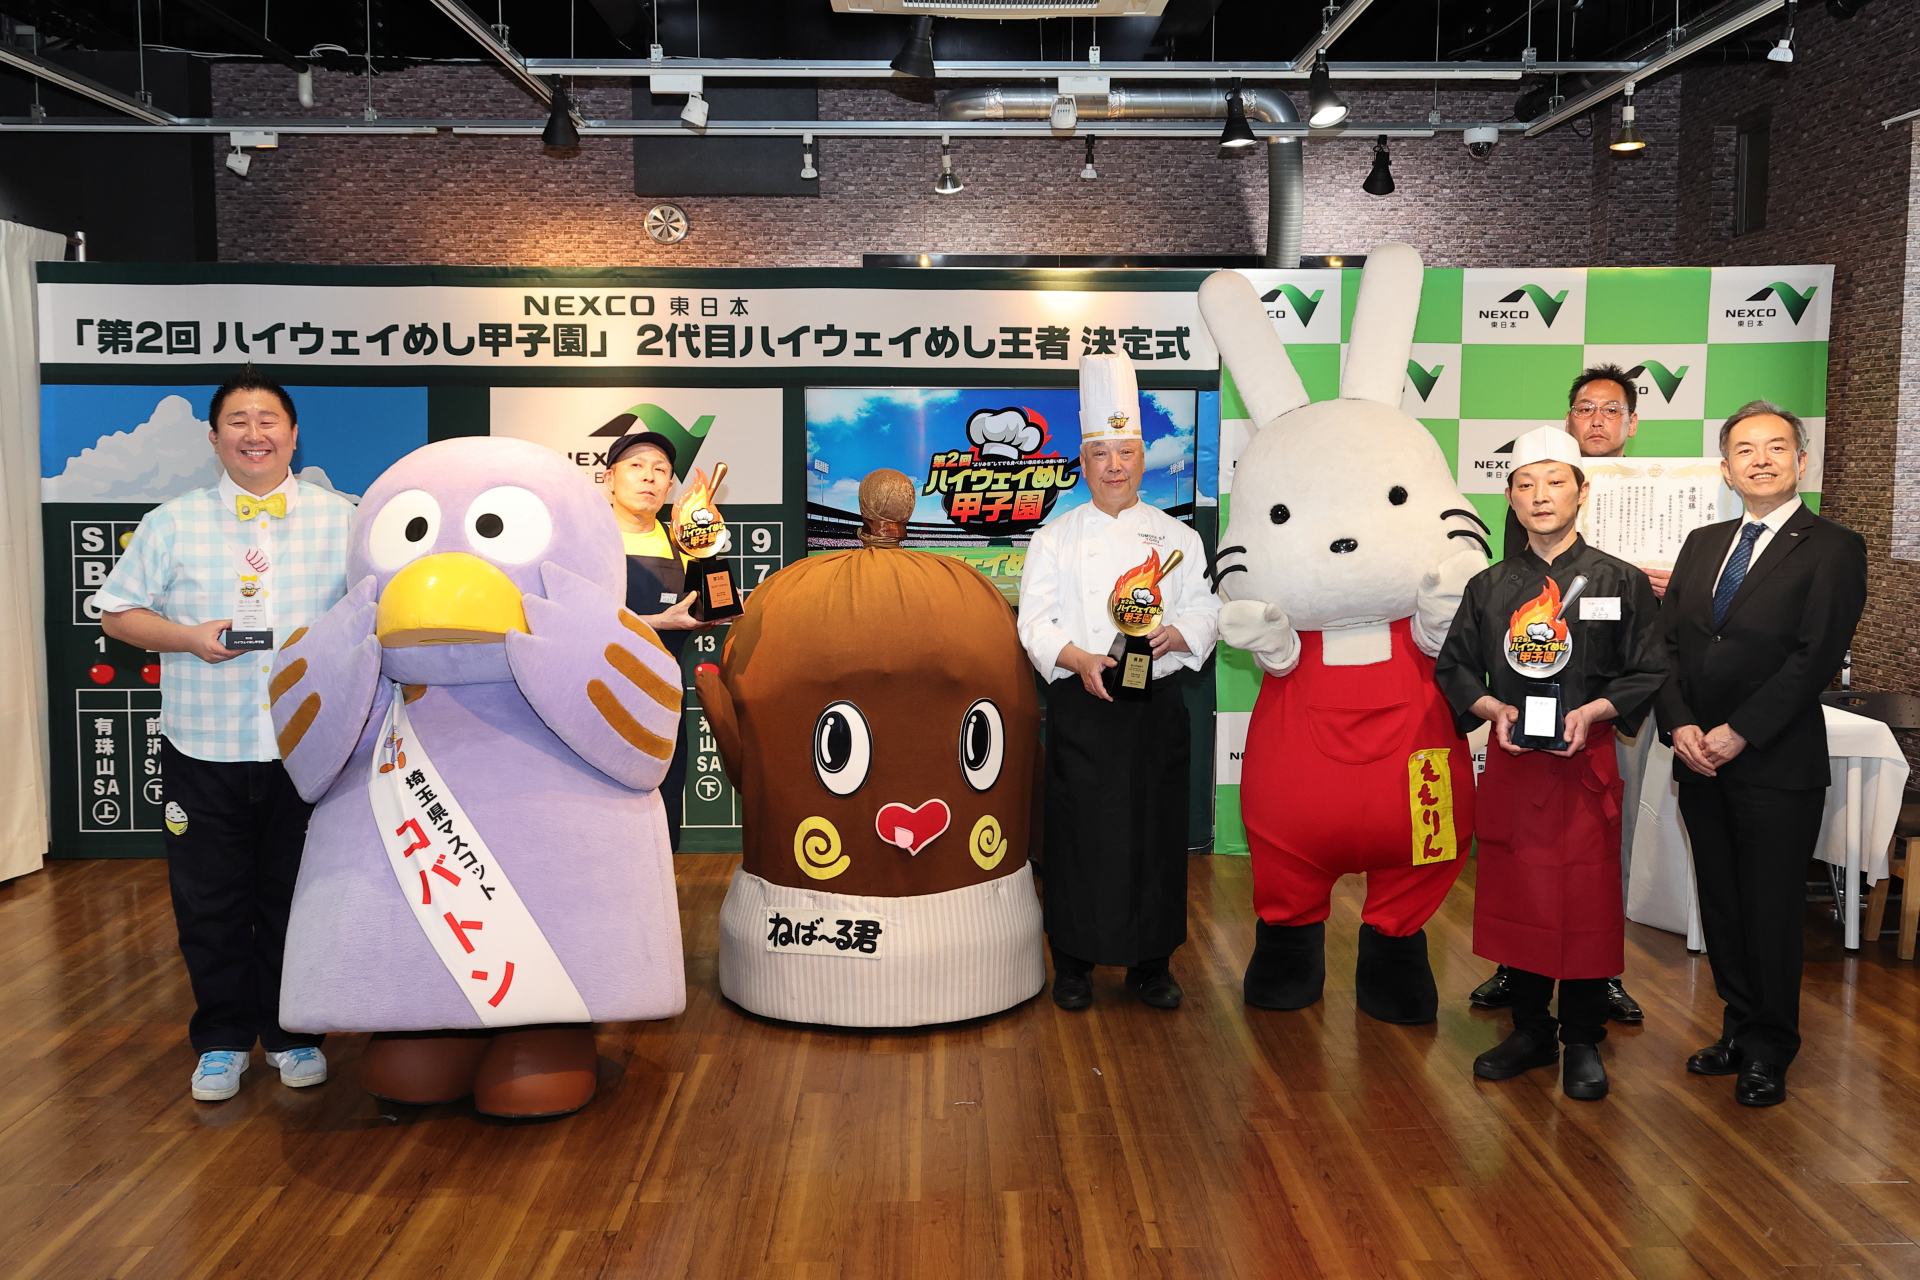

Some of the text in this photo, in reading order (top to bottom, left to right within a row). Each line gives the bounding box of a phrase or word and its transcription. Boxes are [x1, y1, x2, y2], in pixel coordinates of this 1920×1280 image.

[524, 295, 749, 317] NEXCO 東日本
[1478, 310, 1529, 319] NEXCO
[1725, 308, 1777, 318] NEXCO
[1737, 320, 1764, 328] 東日本
[932, 451, 973, 468] 第2回
[925, 464, 1077, 493] ハイウェイめし
[950, 489, 1046, 523] 甲子園
[81, 526, 105, 553] S
[751, 527, 772, 553] 9
[83, 561, 108, 586] B
[753, 564, 771, 584] 7
[1116, 604, 1163, 615] ハイウェイめし
[1123, 612, 1152, 625] 甲子園
[94, 636, 106, 653] 1
[694, 635, 716, 652] 13
[1509, 641, 1569, 652] ハイウェイめし
[1519, 651, 1556, 664] 甲子園
[405, 768, 496, 902] 埼玉県マスコット
[395, 817, 515, 1009] コバトン
